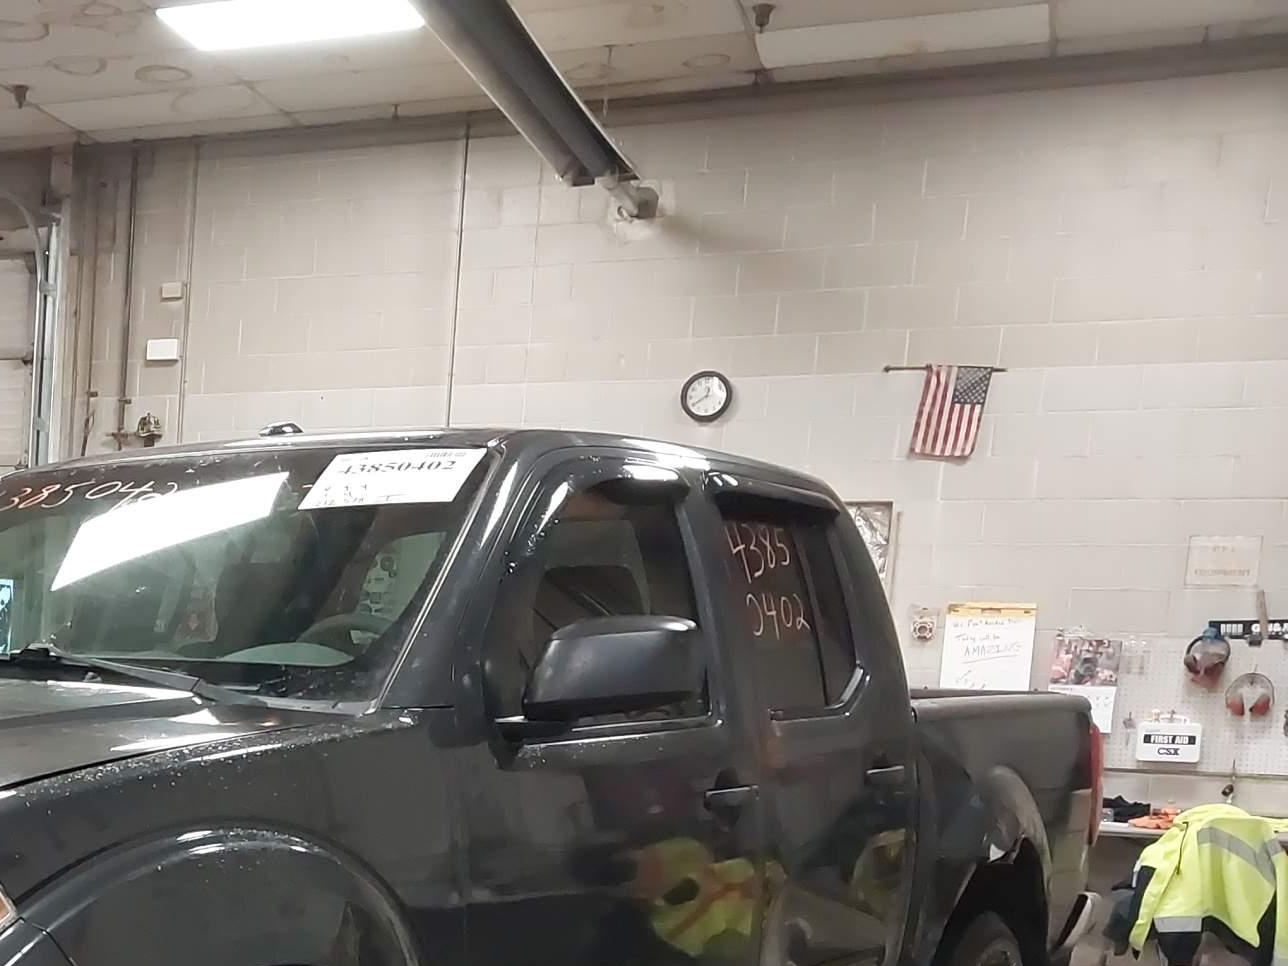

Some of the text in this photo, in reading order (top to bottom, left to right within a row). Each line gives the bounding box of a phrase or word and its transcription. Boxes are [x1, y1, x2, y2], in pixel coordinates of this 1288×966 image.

[339, 460, 456, 475] 43850402
[724, 522, 791, 584] 4385
[1150, 735, 1189, 745] FIRST AID
[1157, 747, 1180, 756] CSX
